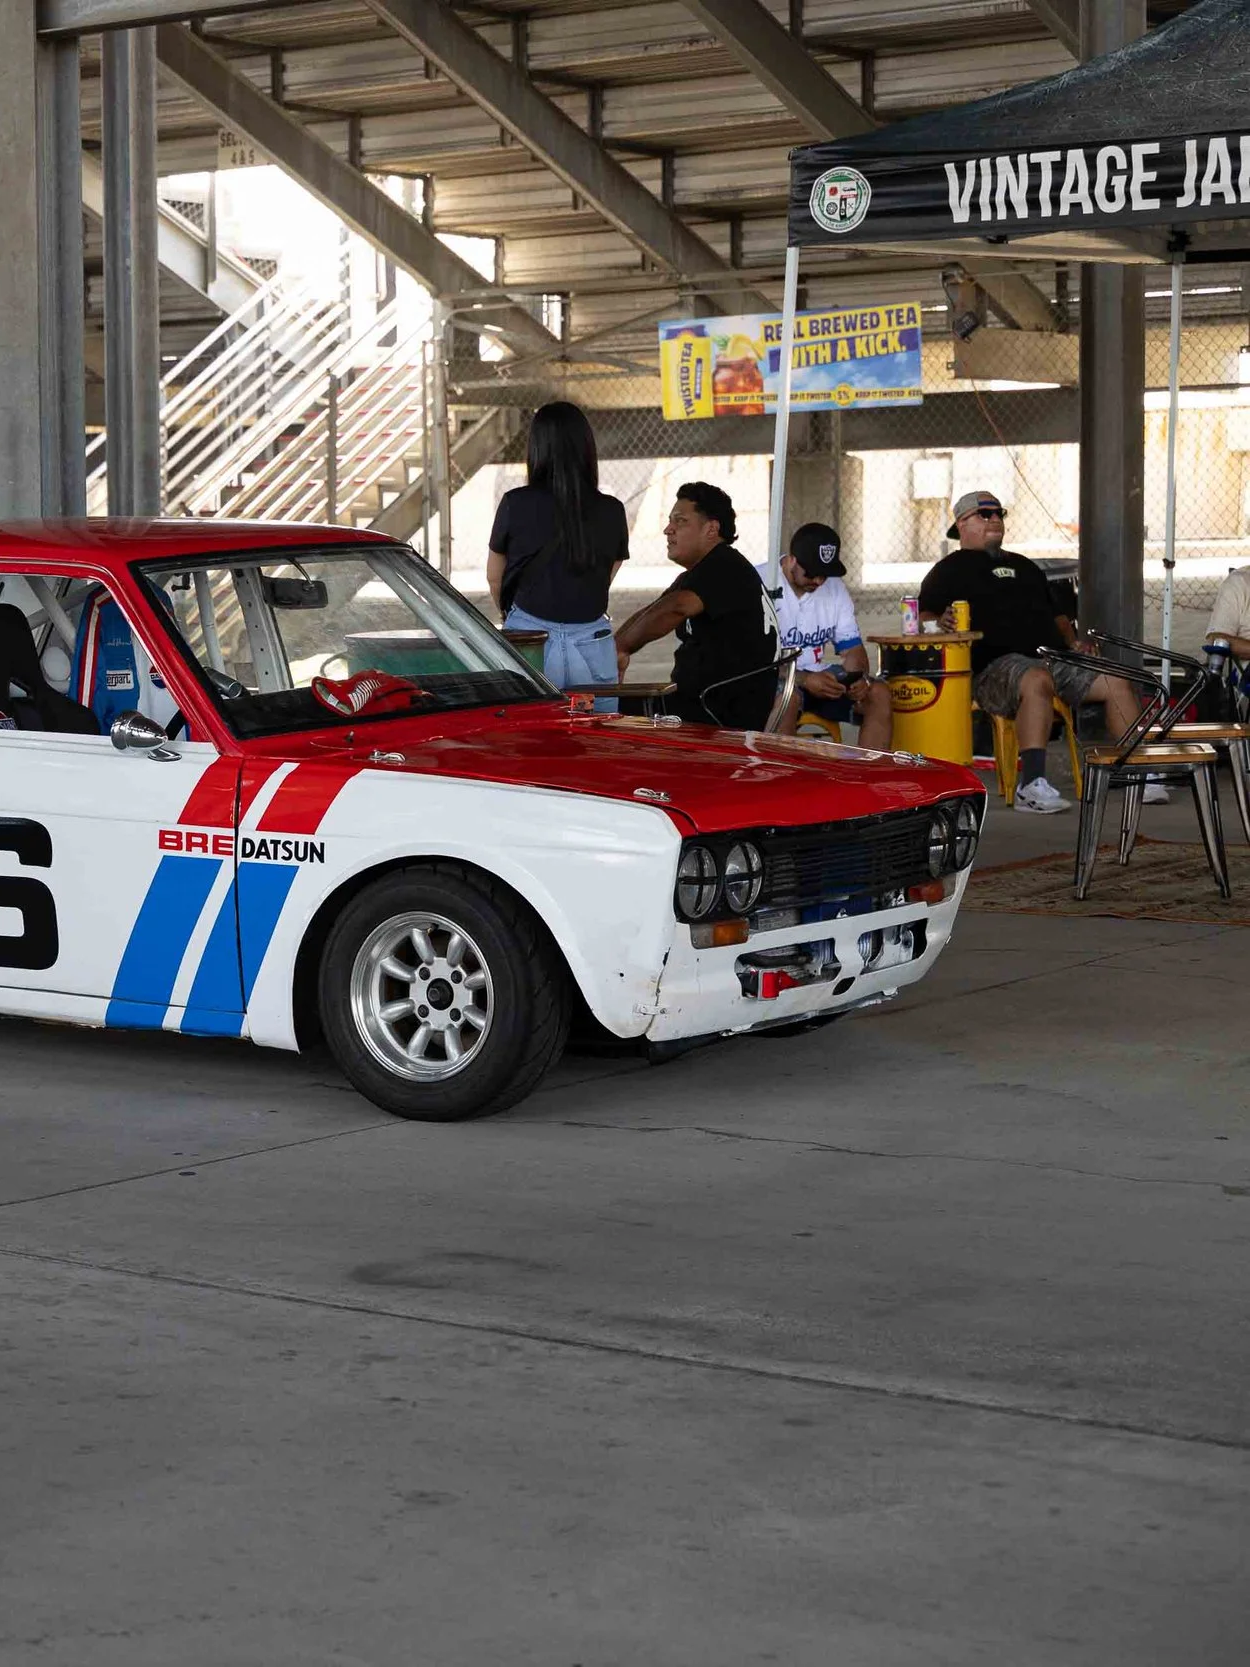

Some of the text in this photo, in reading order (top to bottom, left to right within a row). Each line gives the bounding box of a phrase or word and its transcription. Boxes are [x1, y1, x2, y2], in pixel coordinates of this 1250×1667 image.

[944, 142, 1160, 223] VINTAGE
[809, 312, 881, 337] BREWED
[885, 307, 917, 328] TEA
[837, 339, 851, 361] A
[855, 331, 906, 359] KICK.
[680, 342, 695, 417] TWISTED TEA
[158, 829, 325, 864] BRE DATSUN
